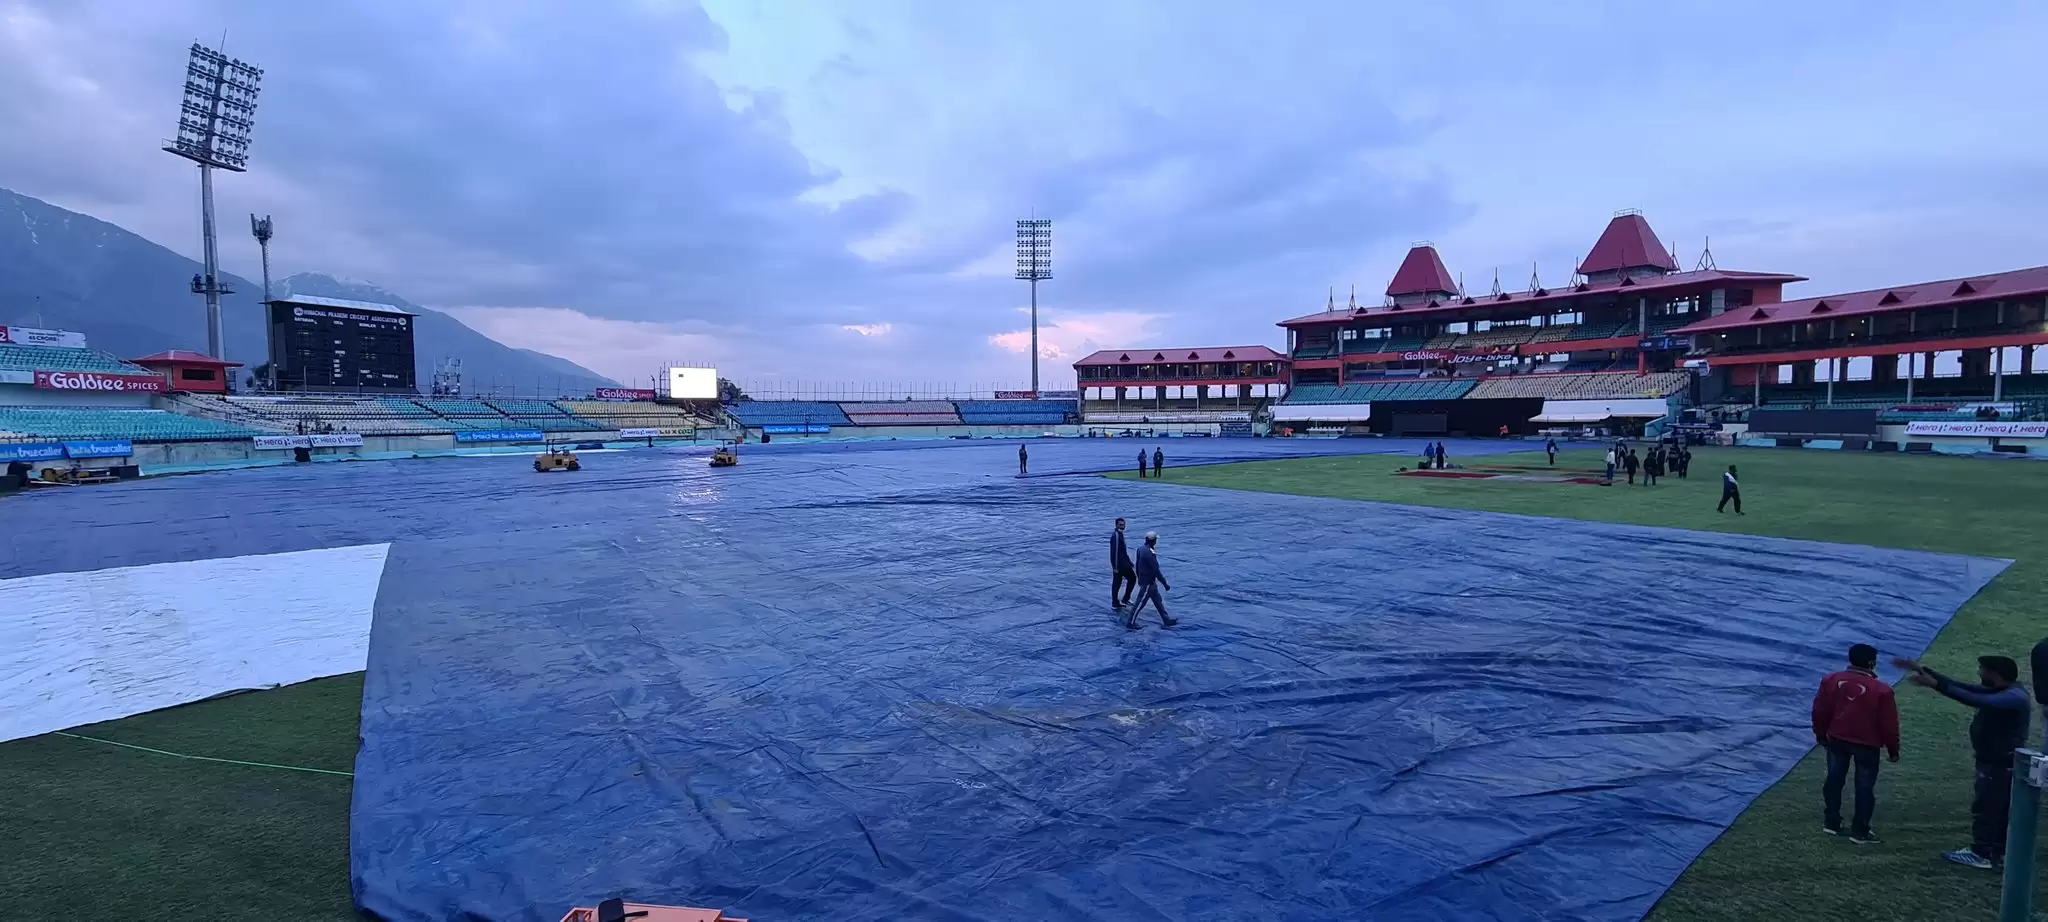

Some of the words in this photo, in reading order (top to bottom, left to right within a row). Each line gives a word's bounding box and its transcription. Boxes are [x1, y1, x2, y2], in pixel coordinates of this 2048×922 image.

[327, 311, 348, 319] PRADESH
[371, 315, 398, 324] ASSOCIATION
[1404, 351, 1440, 361] Goldiee
[49, 372, 125, 391] Goldiee
[126, 382, 159, 391] SPICES
[602, 388, 638, 399] Goldiee
[2019, 425, 2046, 434] Hero
[90, 443, 132, 454] truecaller
